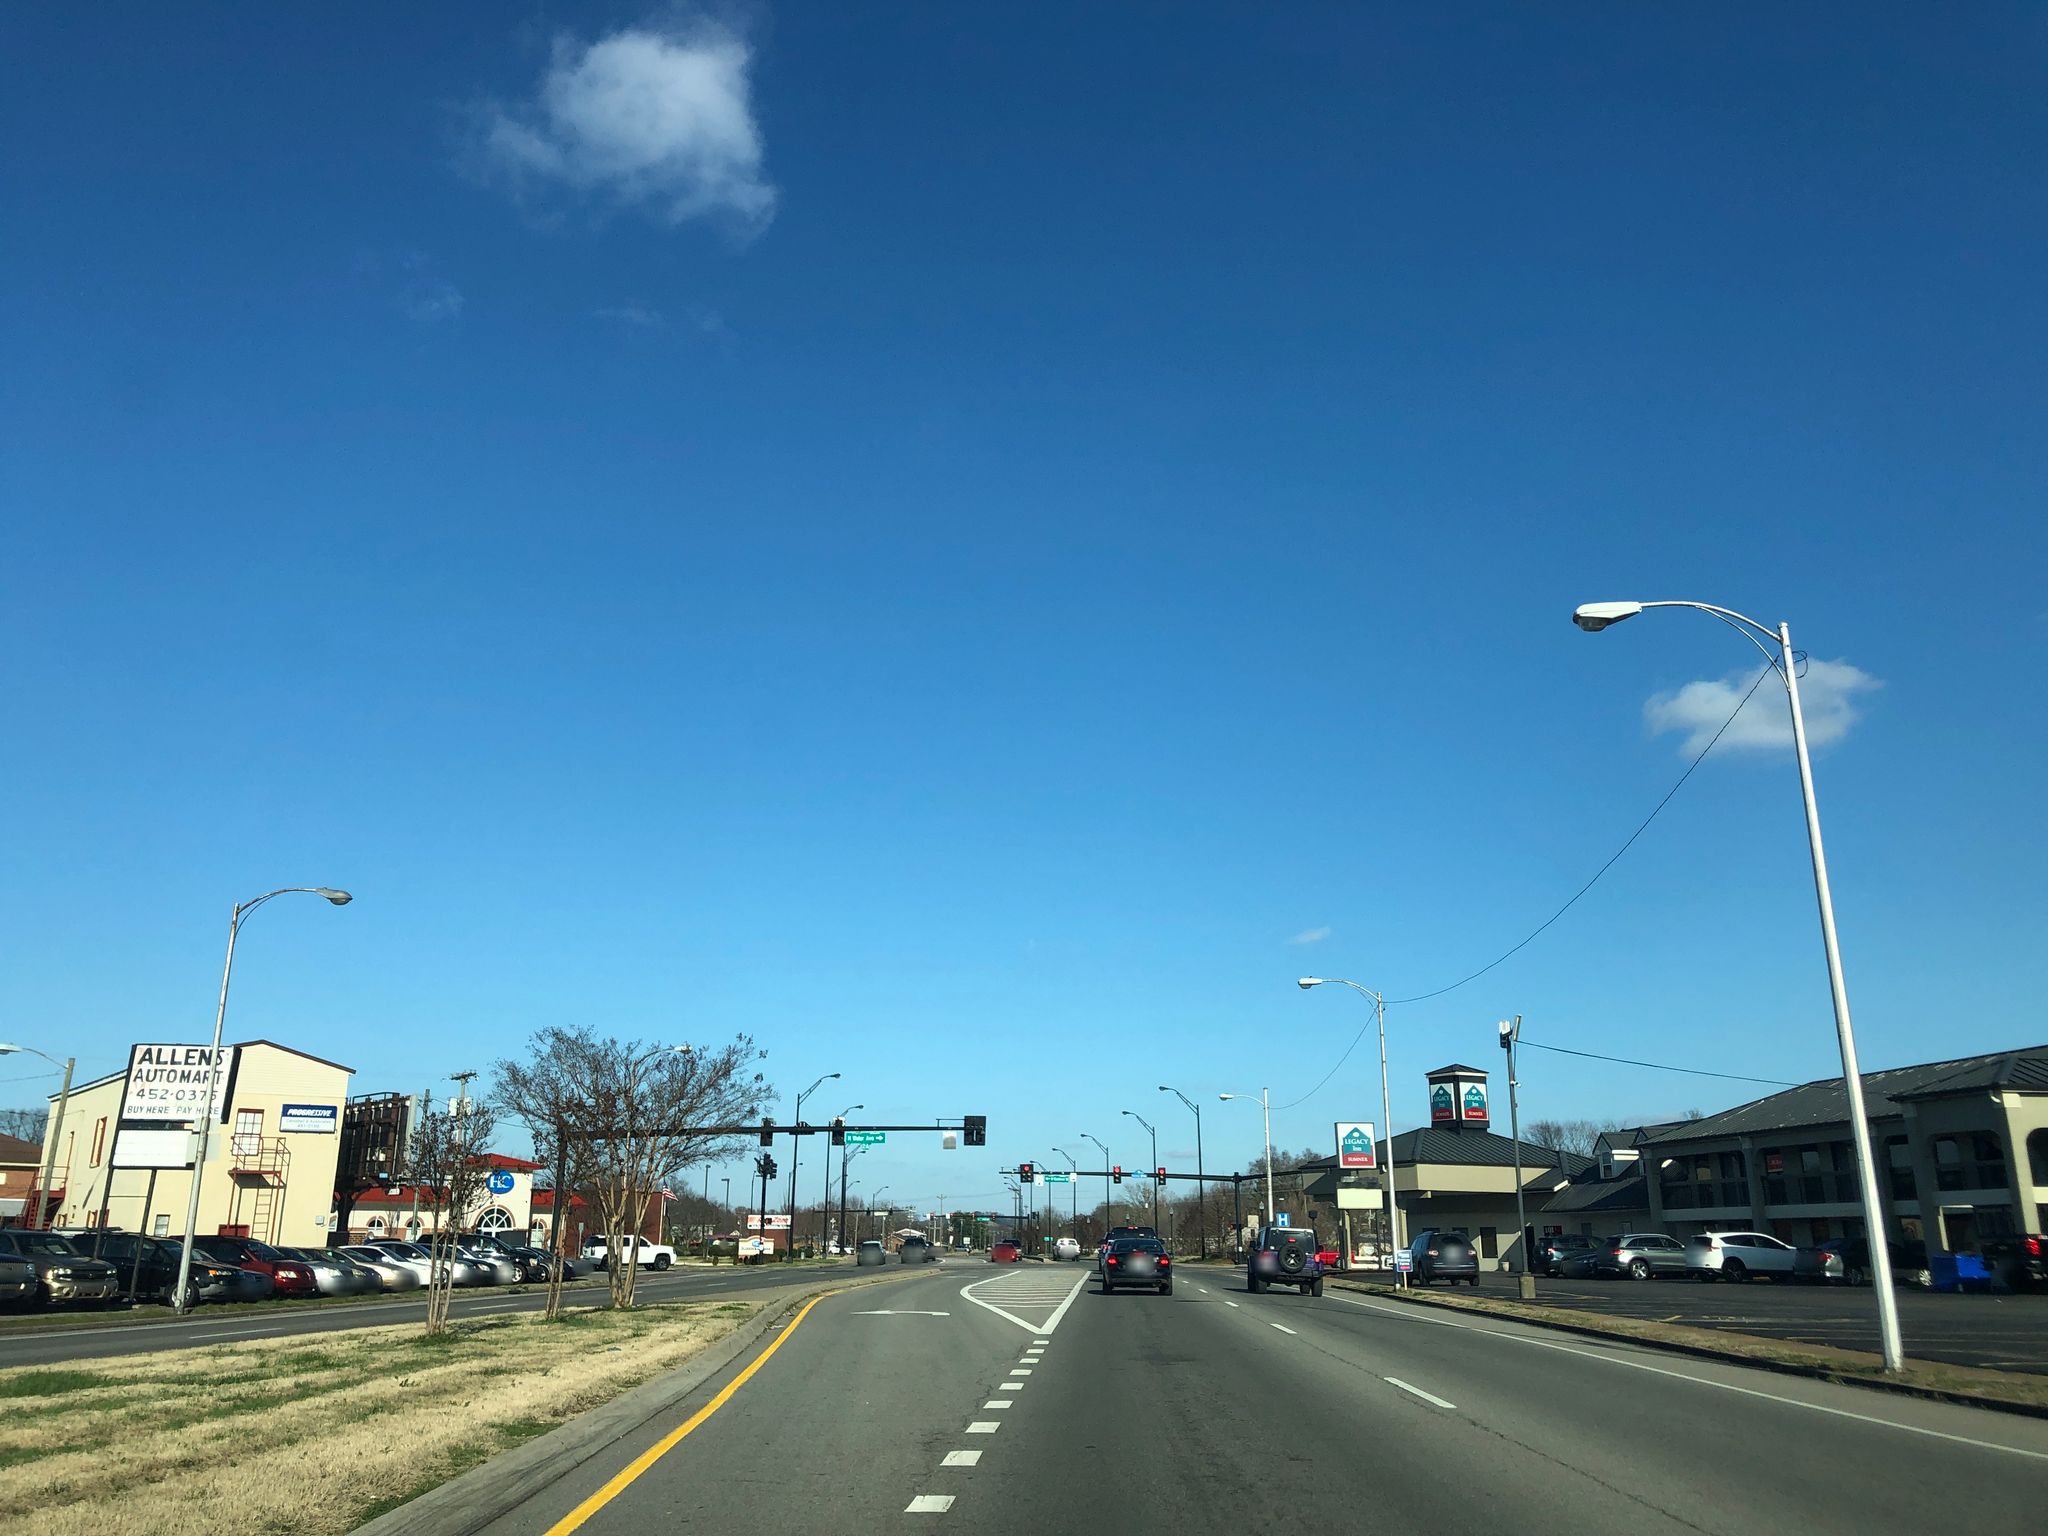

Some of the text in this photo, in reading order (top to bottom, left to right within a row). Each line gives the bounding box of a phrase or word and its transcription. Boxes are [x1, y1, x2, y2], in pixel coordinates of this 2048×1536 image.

[137, 1048, 225, 1066] ALLENS
[133, 1068, 223, 1084] AUTOMART
[127, 1106, 145, 1114] BUY
[146, 1106, 170, 1114] HERE
[176, 1106, 193, 1114] PAY
[287, 1108, 333, 1117] PROGRESSIVE
[1278, 1213, 1288, 1227] H
